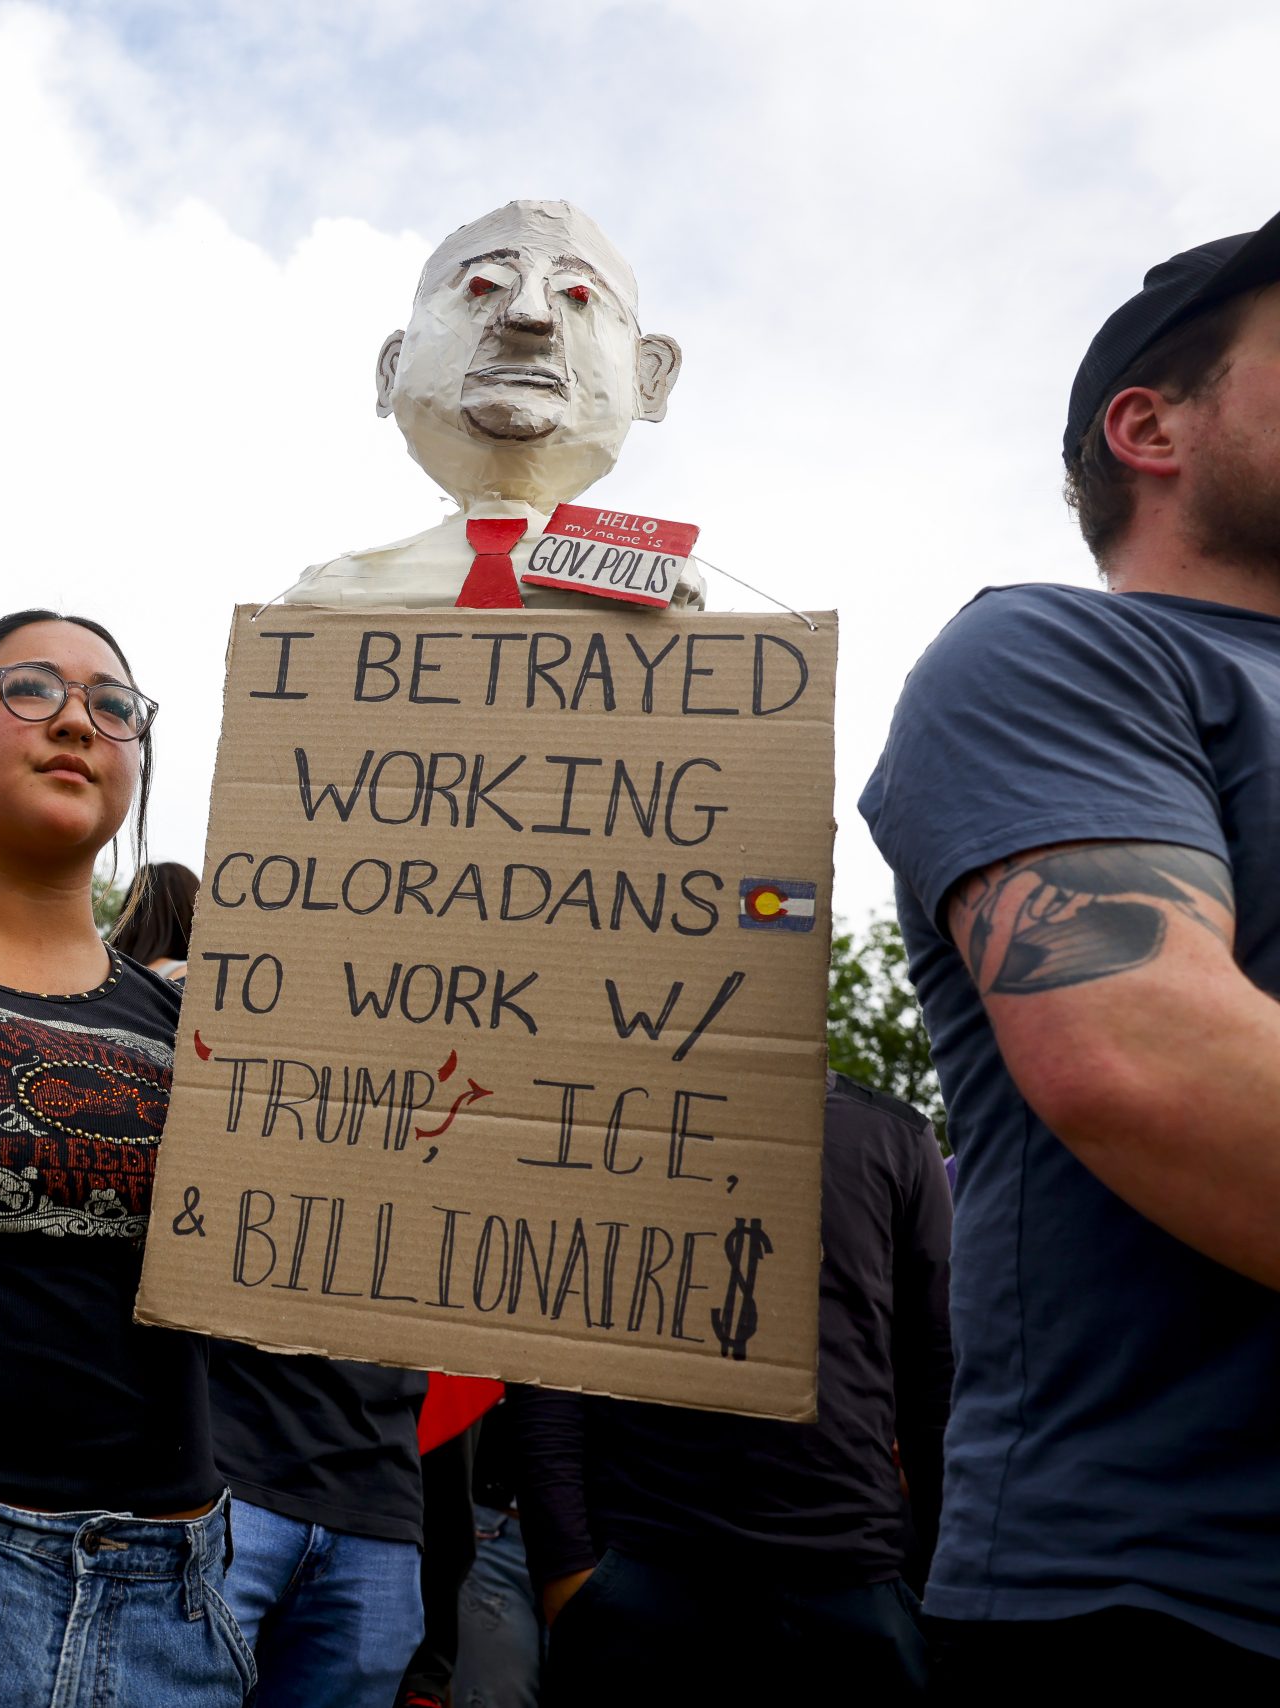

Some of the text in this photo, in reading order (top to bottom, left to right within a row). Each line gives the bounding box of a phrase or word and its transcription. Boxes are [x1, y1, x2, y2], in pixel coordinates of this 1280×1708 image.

[528, 536, 677, 594] GOV. POLIS
[564, 522, 663, 549] my name is
[596, 512, 658, 534] HELLO
[249, 630, 810, 716] I BETRAYED
[294, 747, 729, 846] WORKING
[211, 852, 725, 937] COLORADANS
[201, 952, 746, 1061] TO WORK W/
[517, 1078, 741, 1194] ICE,
[172, 1186, 774, 1361] & BILLIONAIRE$
